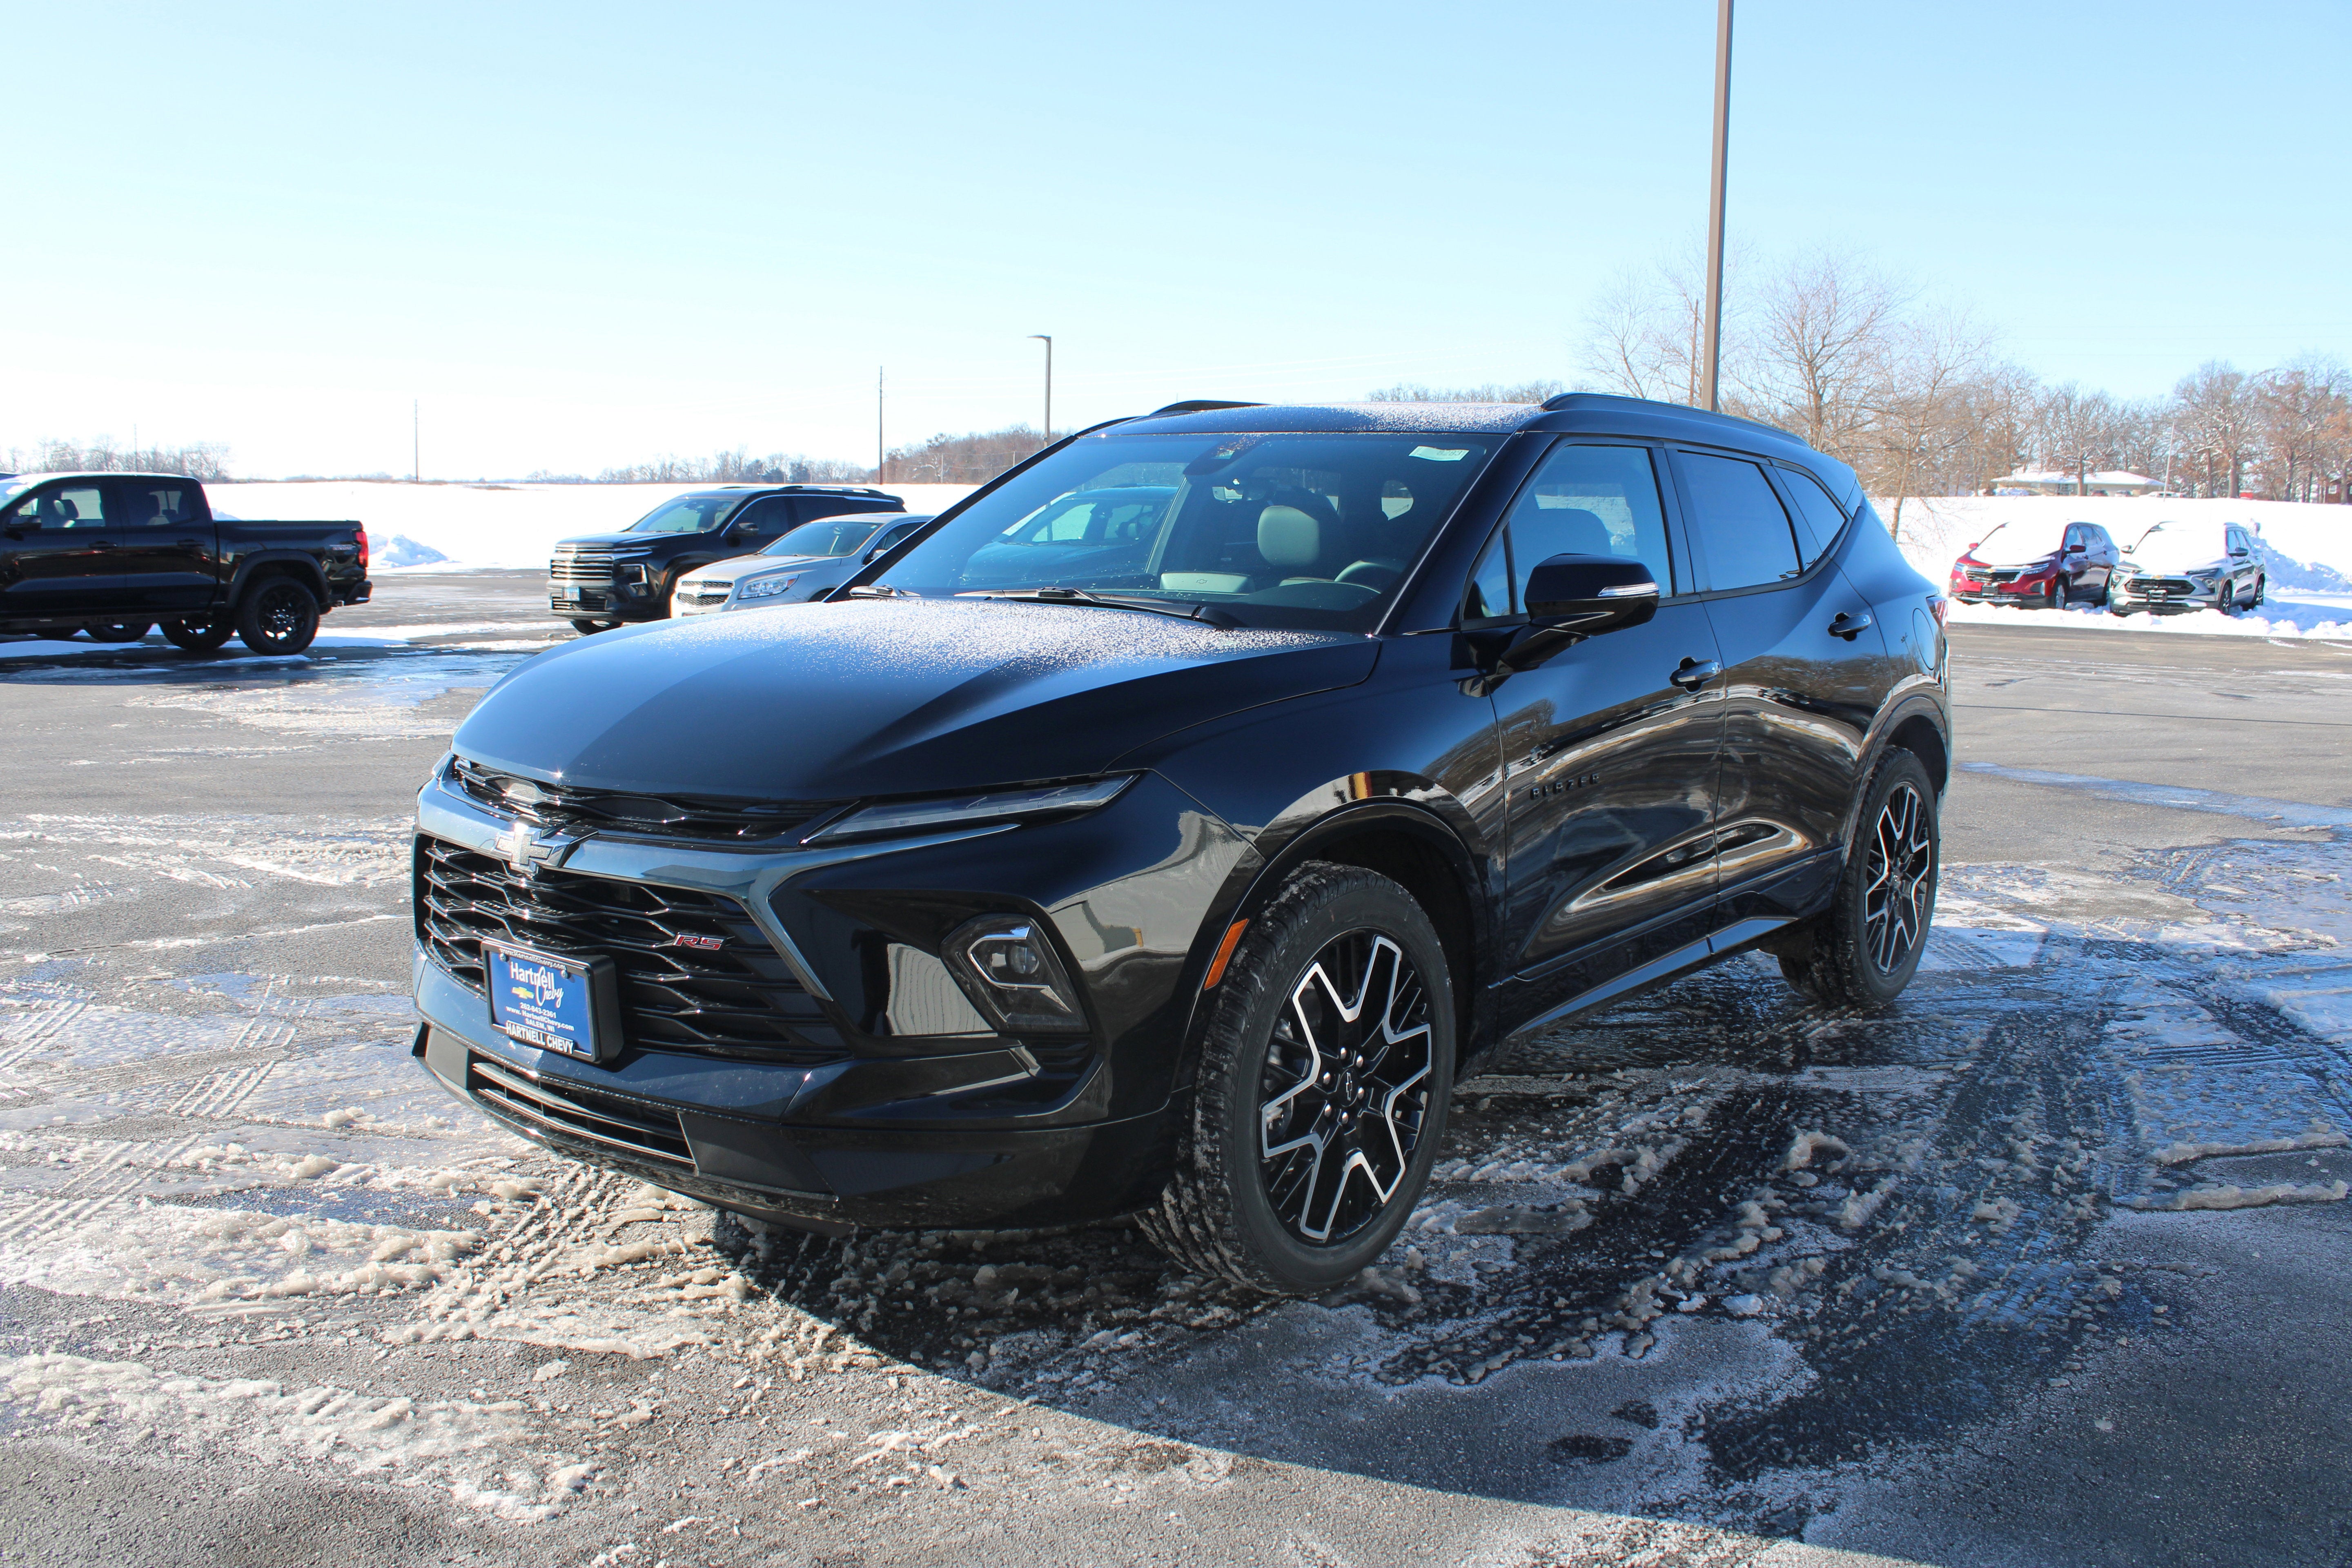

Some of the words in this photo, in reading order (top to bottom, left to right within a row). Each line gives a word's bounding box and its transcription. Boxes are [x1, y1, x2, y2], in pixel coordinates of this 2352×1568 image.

[674, 934, 725, 950] RS
[510, 961, 555, 989] Hartnell
[536, 966, 564, 1008] Chevy
[520, 1002, 557, 1018] 262-843-2361
[526, 1018, 546, 1031] SALEM,
[506, 1022, 546, 1046] HARTNELL
[546, 1035, 575, 1054] CHEVY
